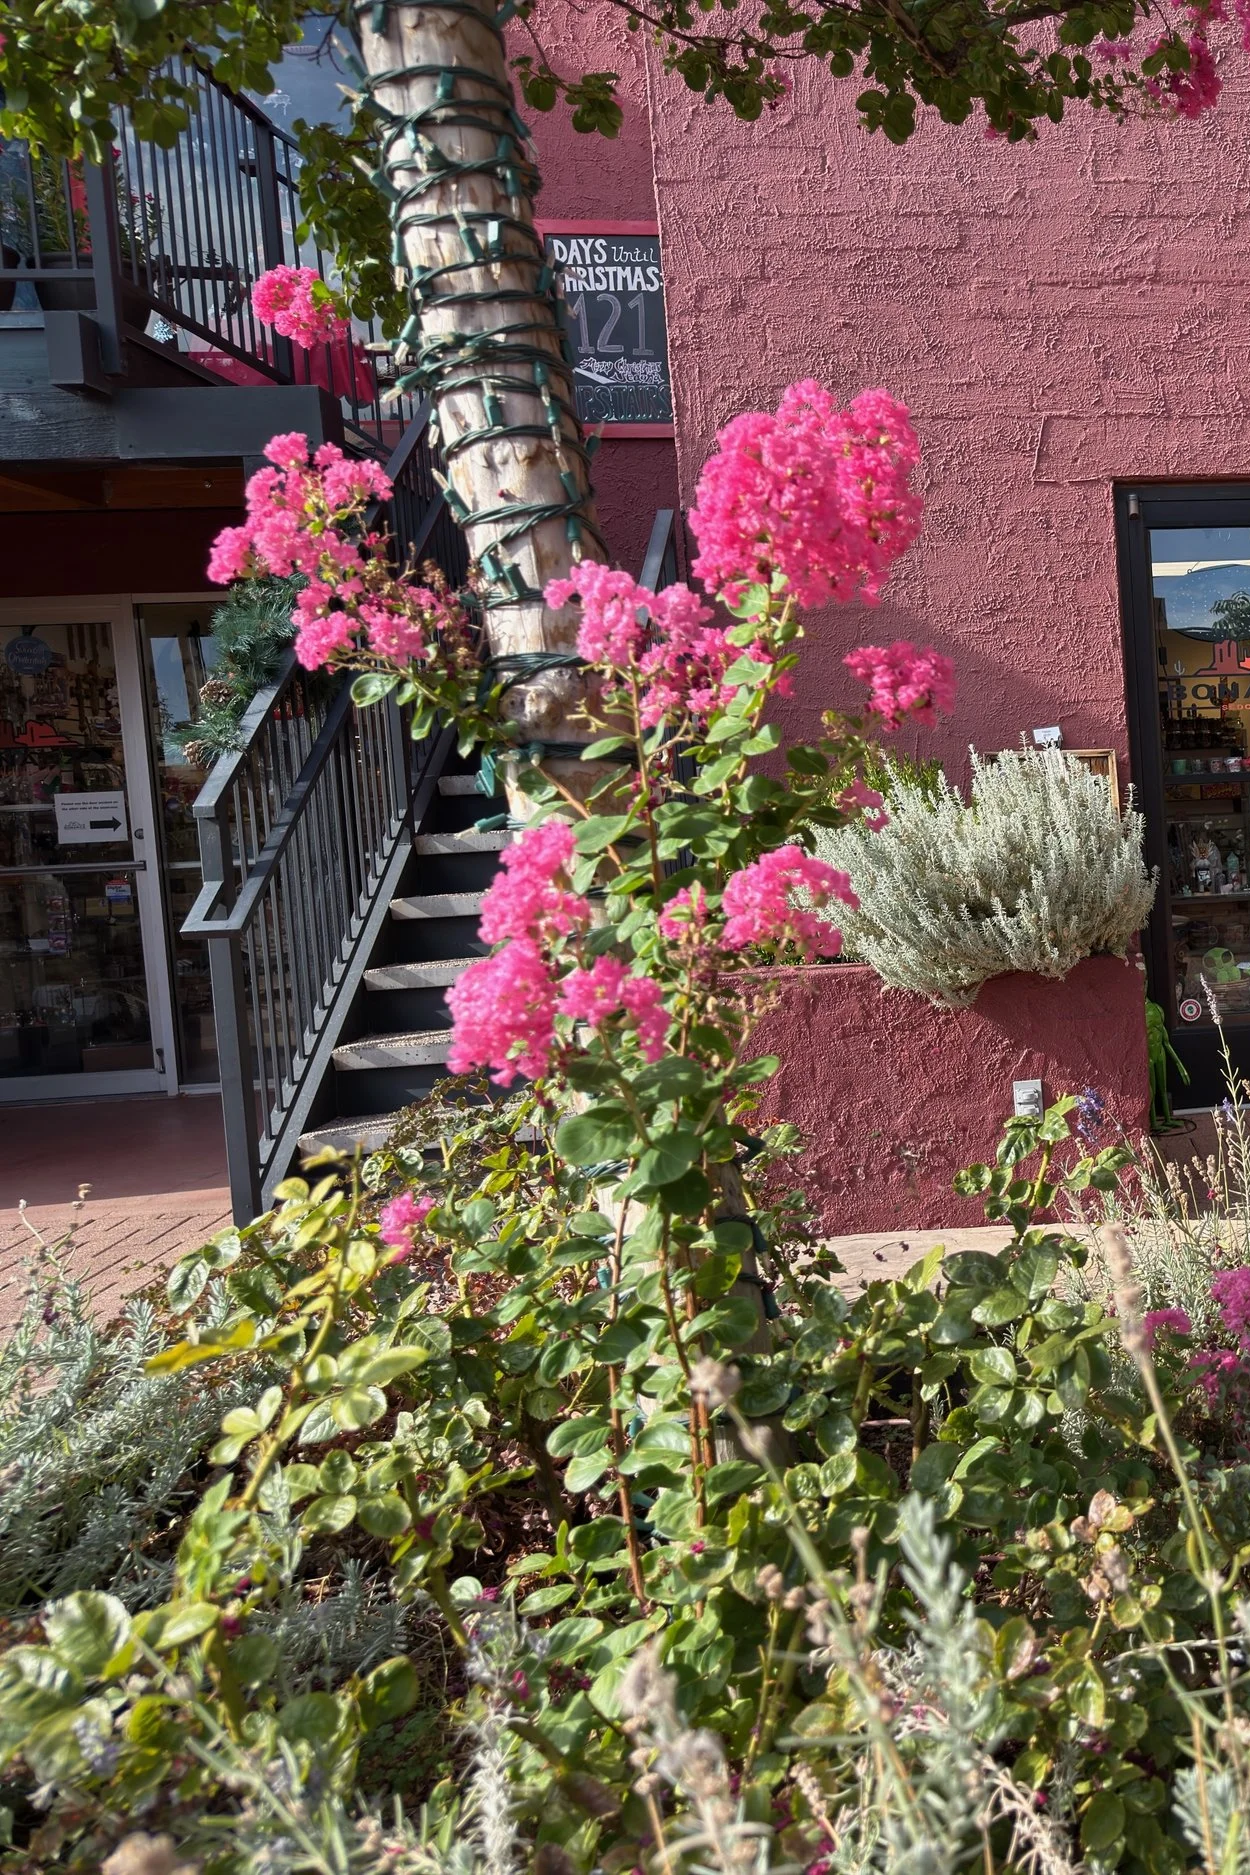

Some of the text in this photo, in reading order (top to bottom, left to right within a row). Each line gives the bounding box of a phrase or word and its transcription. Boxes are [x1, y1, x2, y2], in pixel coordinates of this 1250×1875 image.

[552, 238, 658, 265] DAYS Until
[553, 266, 664, 292] HRISTMAS:
[572, 292, 655, 356] 121
[575, 385, 673, 421] PSTAIRS
